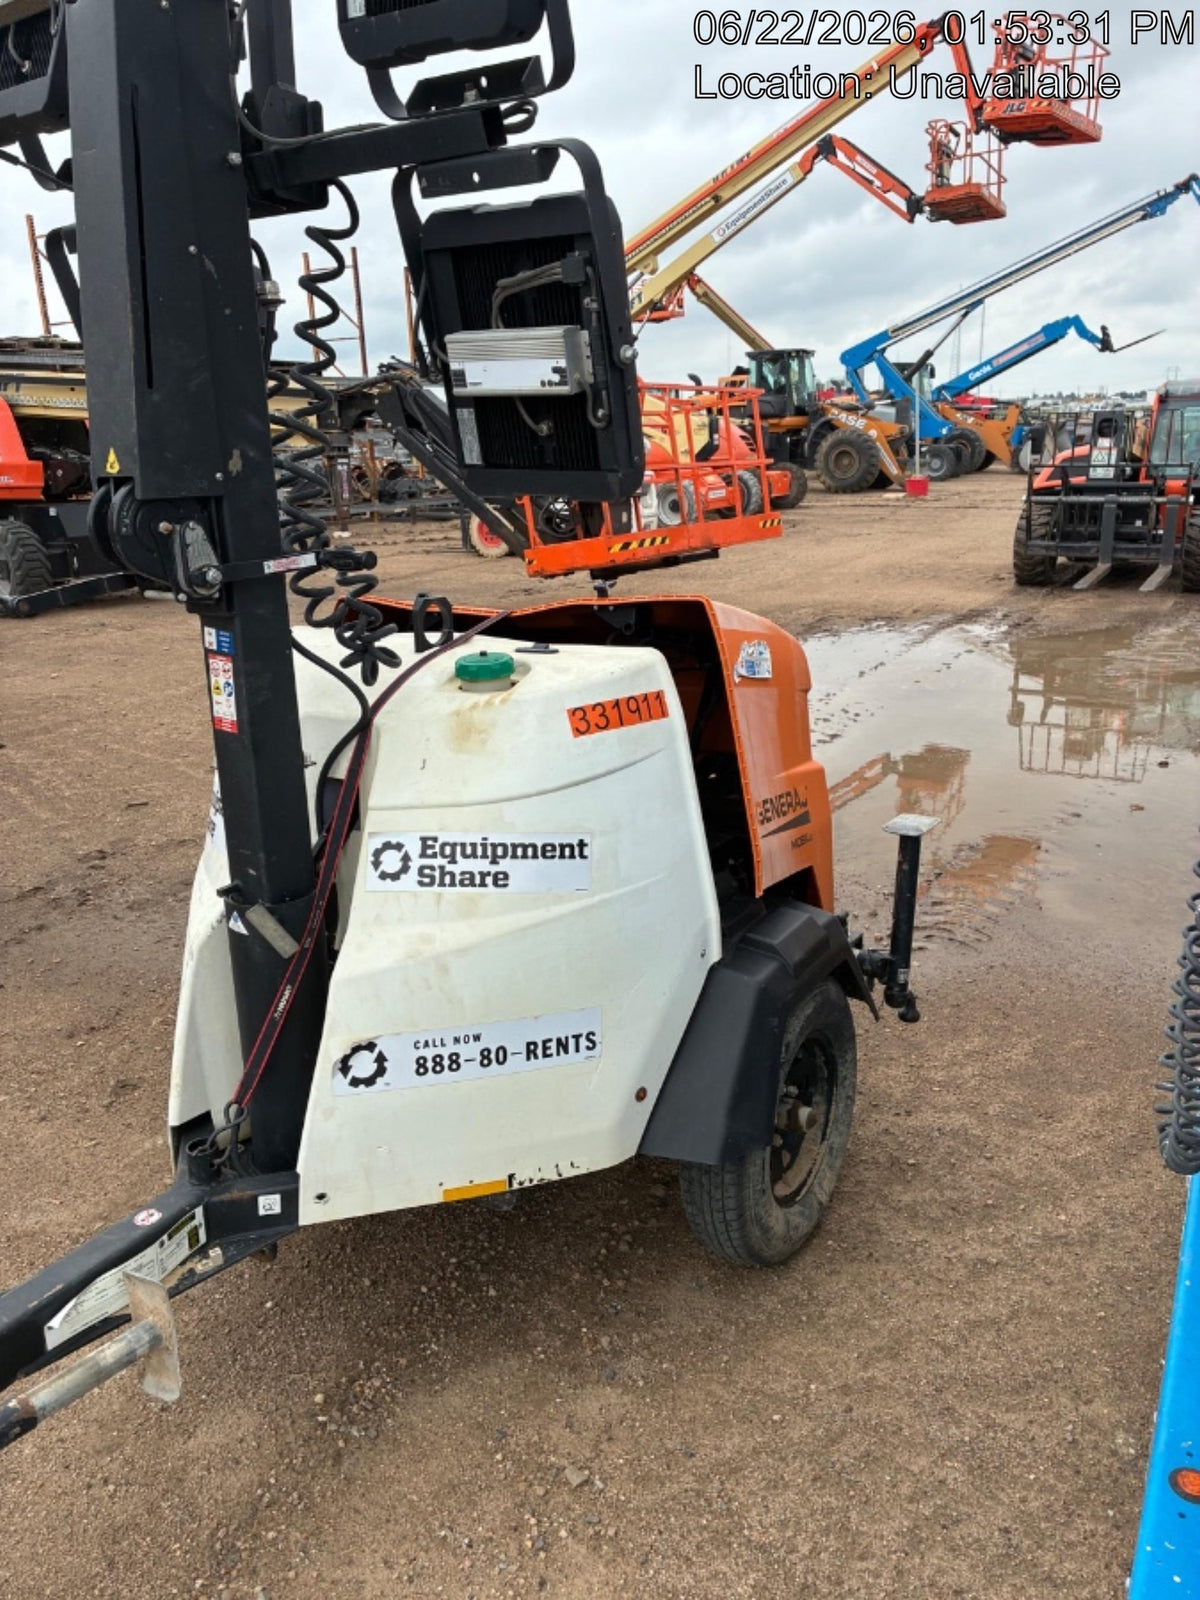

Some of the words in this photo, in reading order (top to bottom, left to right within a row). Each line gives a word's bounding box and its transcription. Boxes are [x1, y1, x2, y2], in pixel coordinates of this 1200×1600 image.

[571, 691, 666, 735] 331911
[418, 835, 589, 865] Equipment
[416, 864, 510, 888] Share
[413, 1038, 447, 1050] CALL
[453, 1033, 483, 1046] NOW
[414, 1031, 597, 1077] 888-80-RENTS
